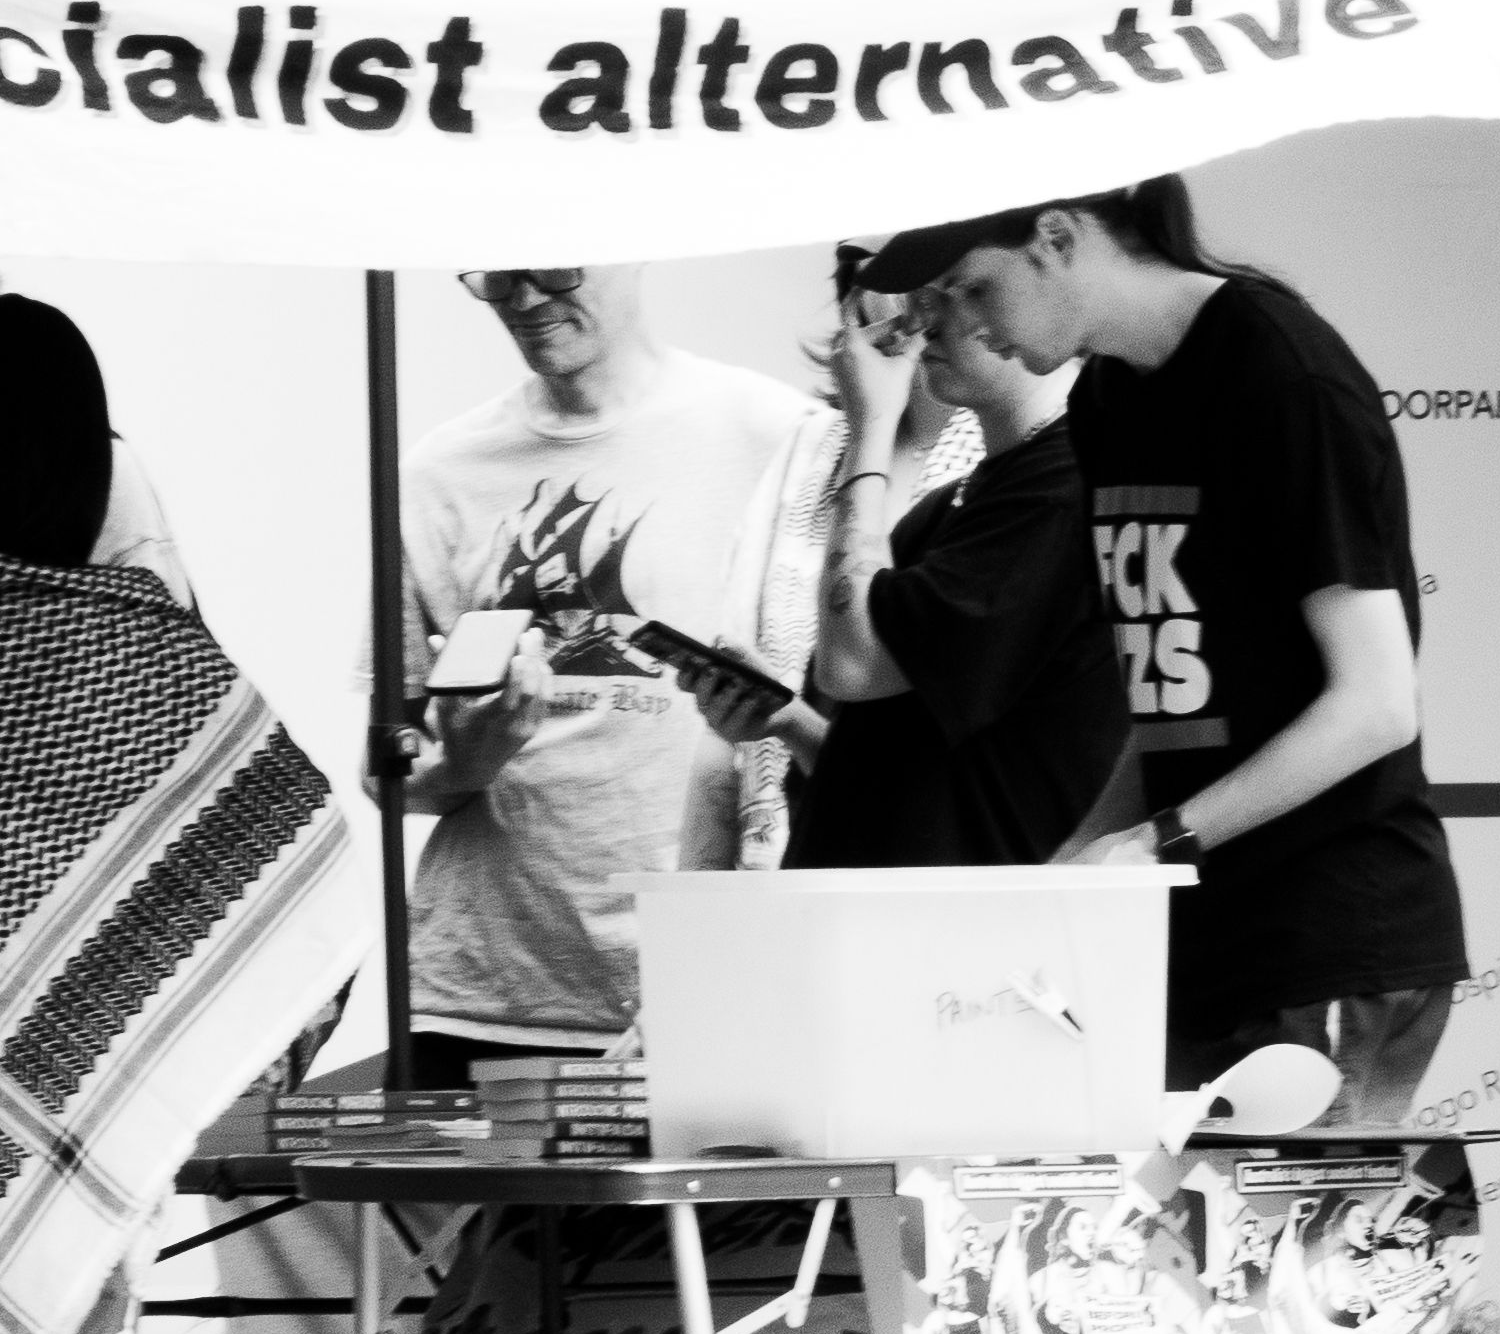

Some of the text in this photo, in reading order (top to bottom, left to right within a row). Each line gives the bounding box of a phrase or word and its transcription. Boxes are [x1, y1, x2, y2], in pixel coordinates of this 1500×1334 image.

[0, 0, 482, 134] cialist
[1092, 521, 1200, 618] FCK
[1113, 618, 1213, 715] ZS
